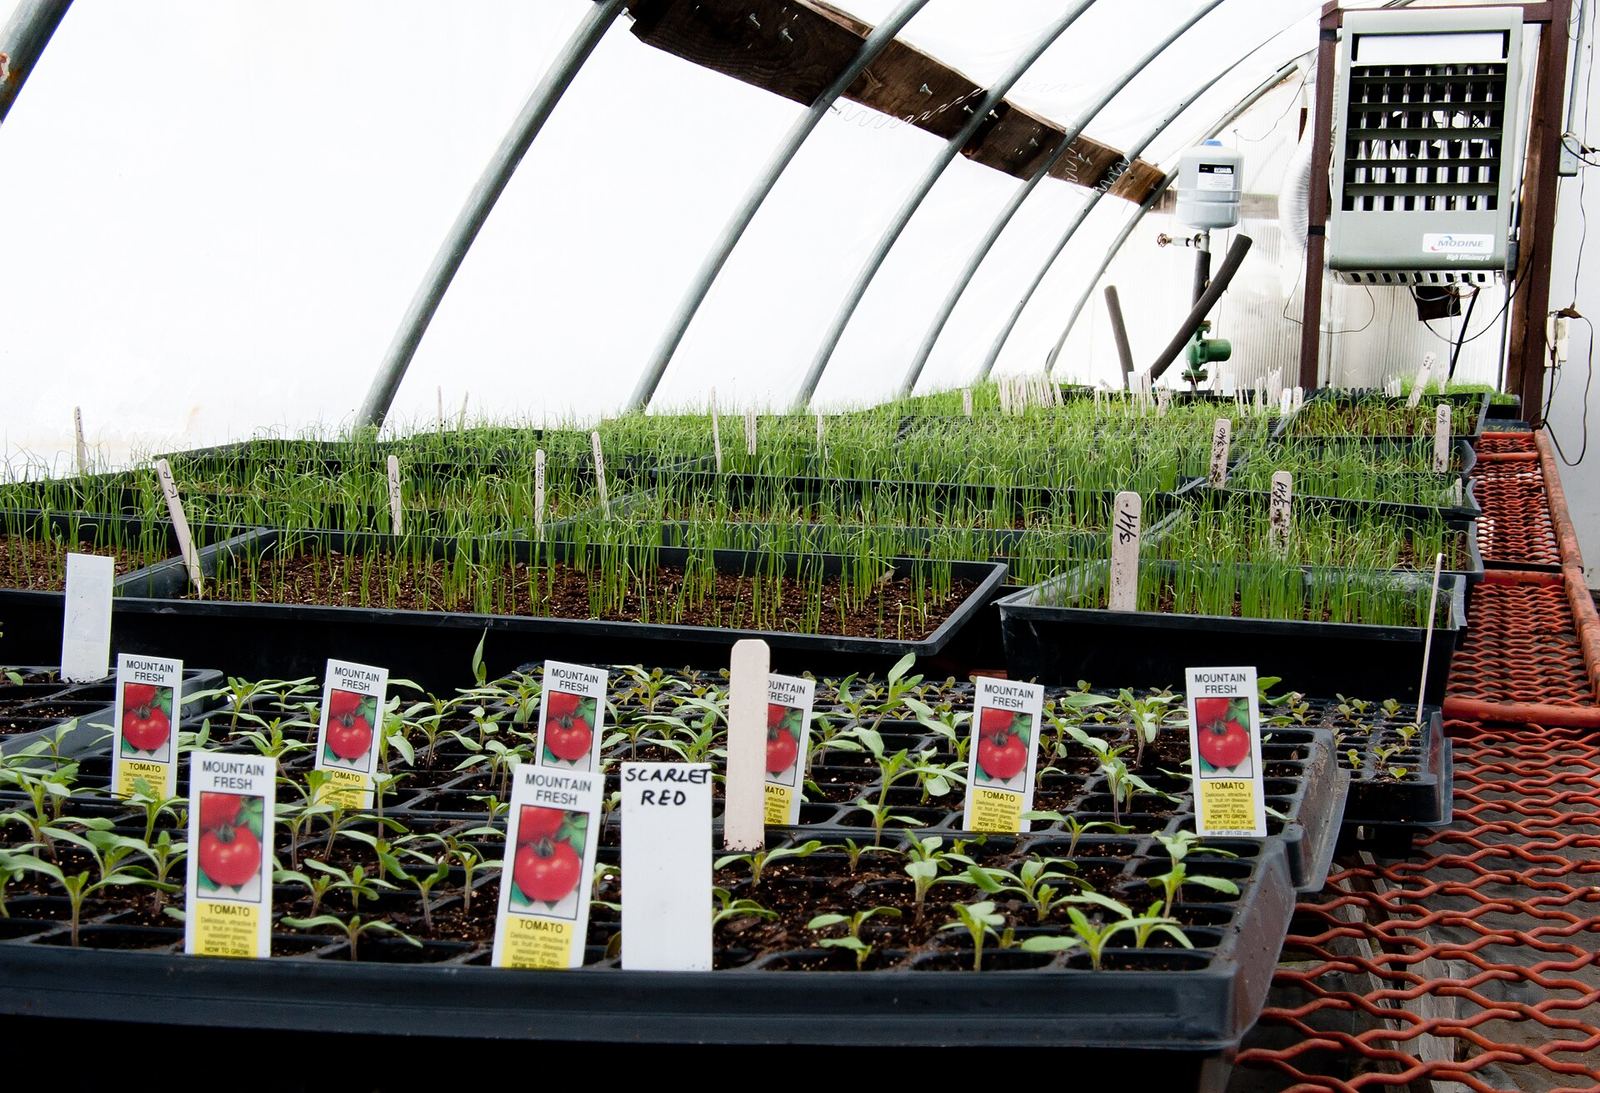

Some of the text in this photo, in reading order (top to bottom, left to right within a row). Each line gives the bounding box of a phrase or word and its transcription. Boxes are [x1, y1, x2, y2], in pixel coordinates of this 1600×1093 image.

[1116, 510, 1138, 545] 3/11
[127, 660, 173, 672] MOUNTAIN
[135, 672, 164, 682] FRESH
[335, 667, 380, 682] MOUNTAIN
[552, 669, 598, 684] MOUNTAIN
[1195, 674, 1246, 682] MOUNTAIN
[342, 679, 370, 691] FRESH
[560, 681, 589, 692] FRESH
[985, 684, 1034, 698] MOUNTAIN
[1205, 685, 1237, 693] FRESH
[993, 697, 1023, 708] FRESH
[129, 763, 161, 772] TOMATO
[202, 761, 264, 776] MOUNTAIN
[625, 768, 711, 784] SCARLET
[214, 777, 252, 790] FRESH
[526, 774, 592, 792] MOUNTAIN
[765, 786, 785, 795] MATO
[983, 791, 1015, 802] TOMATO
[536, 790, 577, 805] FRESH
[641, 789, 686, 806] RED
[209, 904, 250, 916] TOMATO
[520, 919, 563, 933] TOMATO
